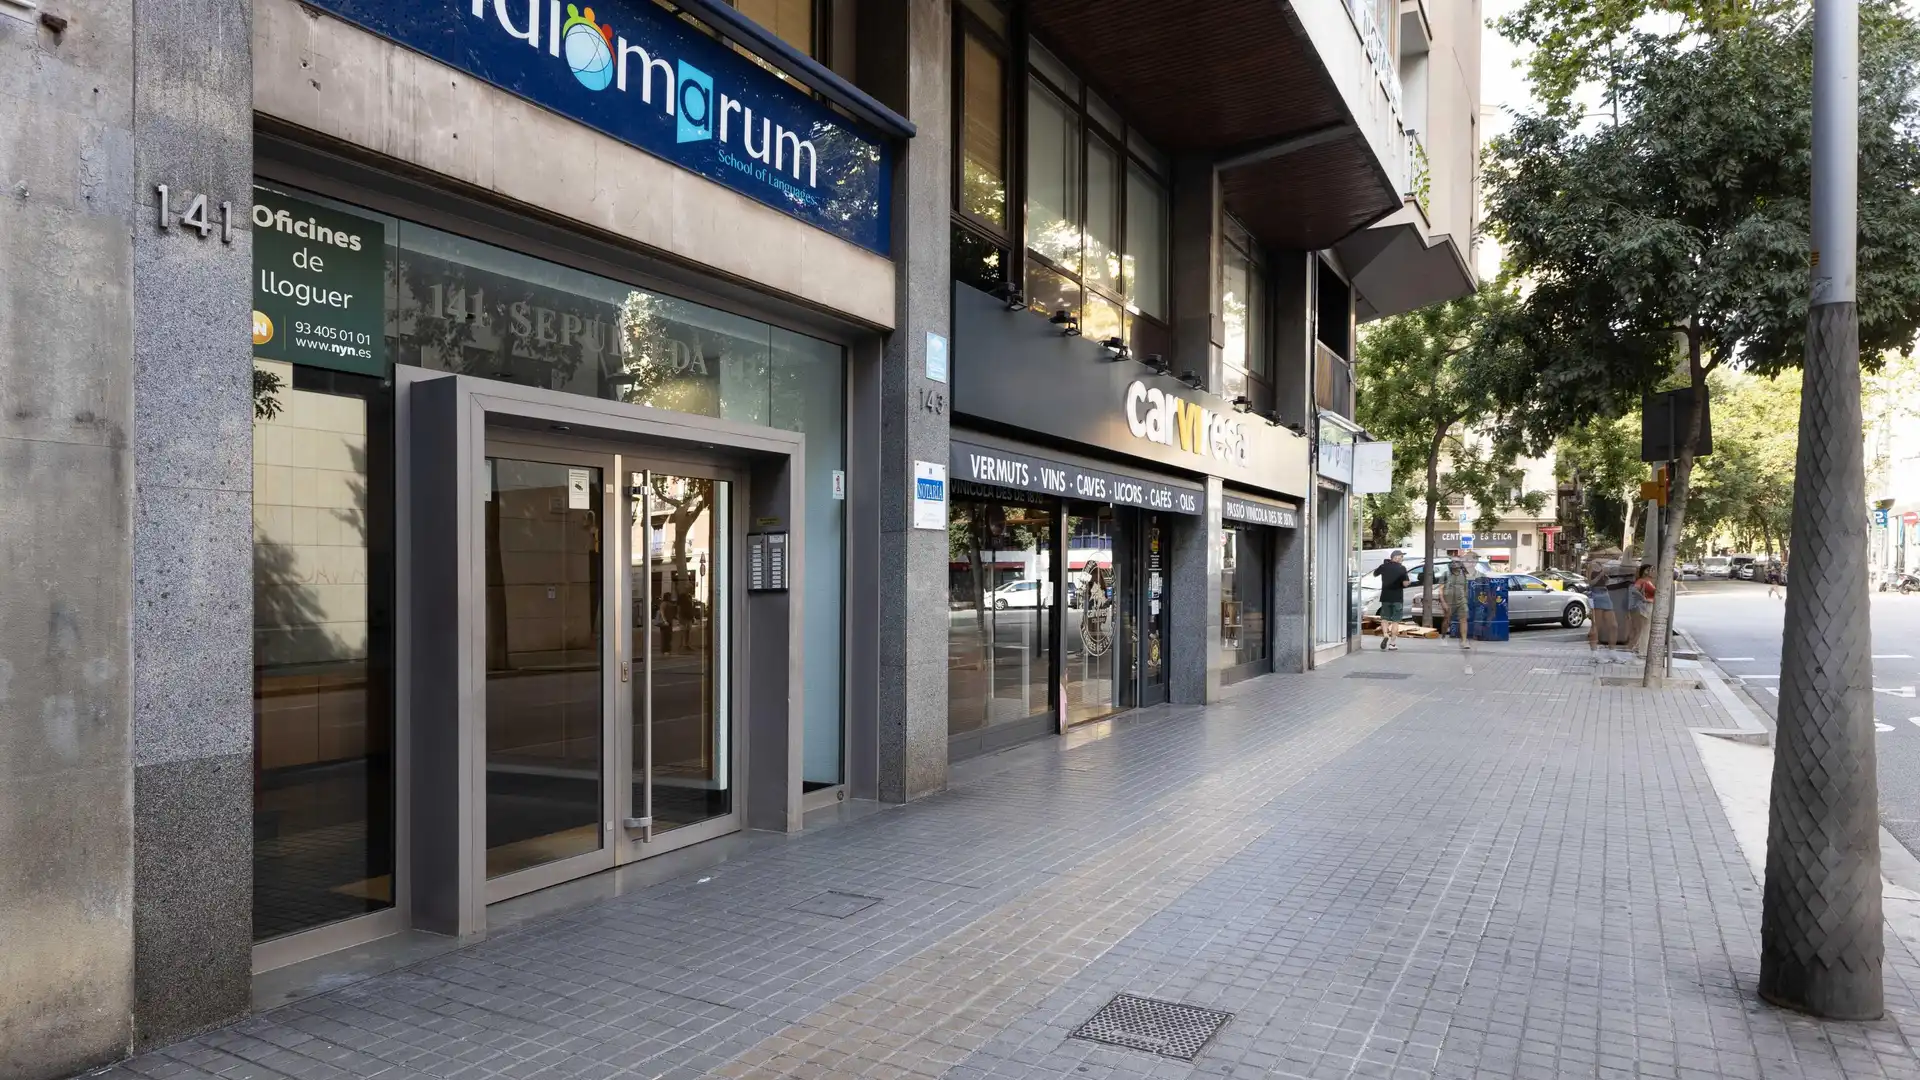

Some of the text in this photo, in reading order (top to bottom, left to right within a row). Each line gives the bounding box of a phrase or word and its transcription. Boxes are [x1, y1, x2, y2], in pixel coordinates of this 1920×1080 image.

[718, 149, 753, 176] School
[755, 168, 767, 182] of
[157, 184, 232, 243] 141
[252, 204, 362, 252] Oficines
[292, 247, 324, 272] de
[261, 269, 353, 309] lloguer
[429, 284, 486, 328] 141
[295, 321, 371, 346] 93 405 01 01
[295, 337, 372, 359] www.nyn.es
[919, 387, 945, 416] 143
[970, 453, 1029, 486] VERMUTS
[1040, 466, 1066, 492] VINS
[1076, 474, 1106, 499] CAVES
[1114, 481, 1142, 504] LICORS
[1180, 493, 1195, 512] OLIS
[1226, 500, 1245, 519] PASSIÓ
[1245, 504, 1268, 522] VINÍCOLA
